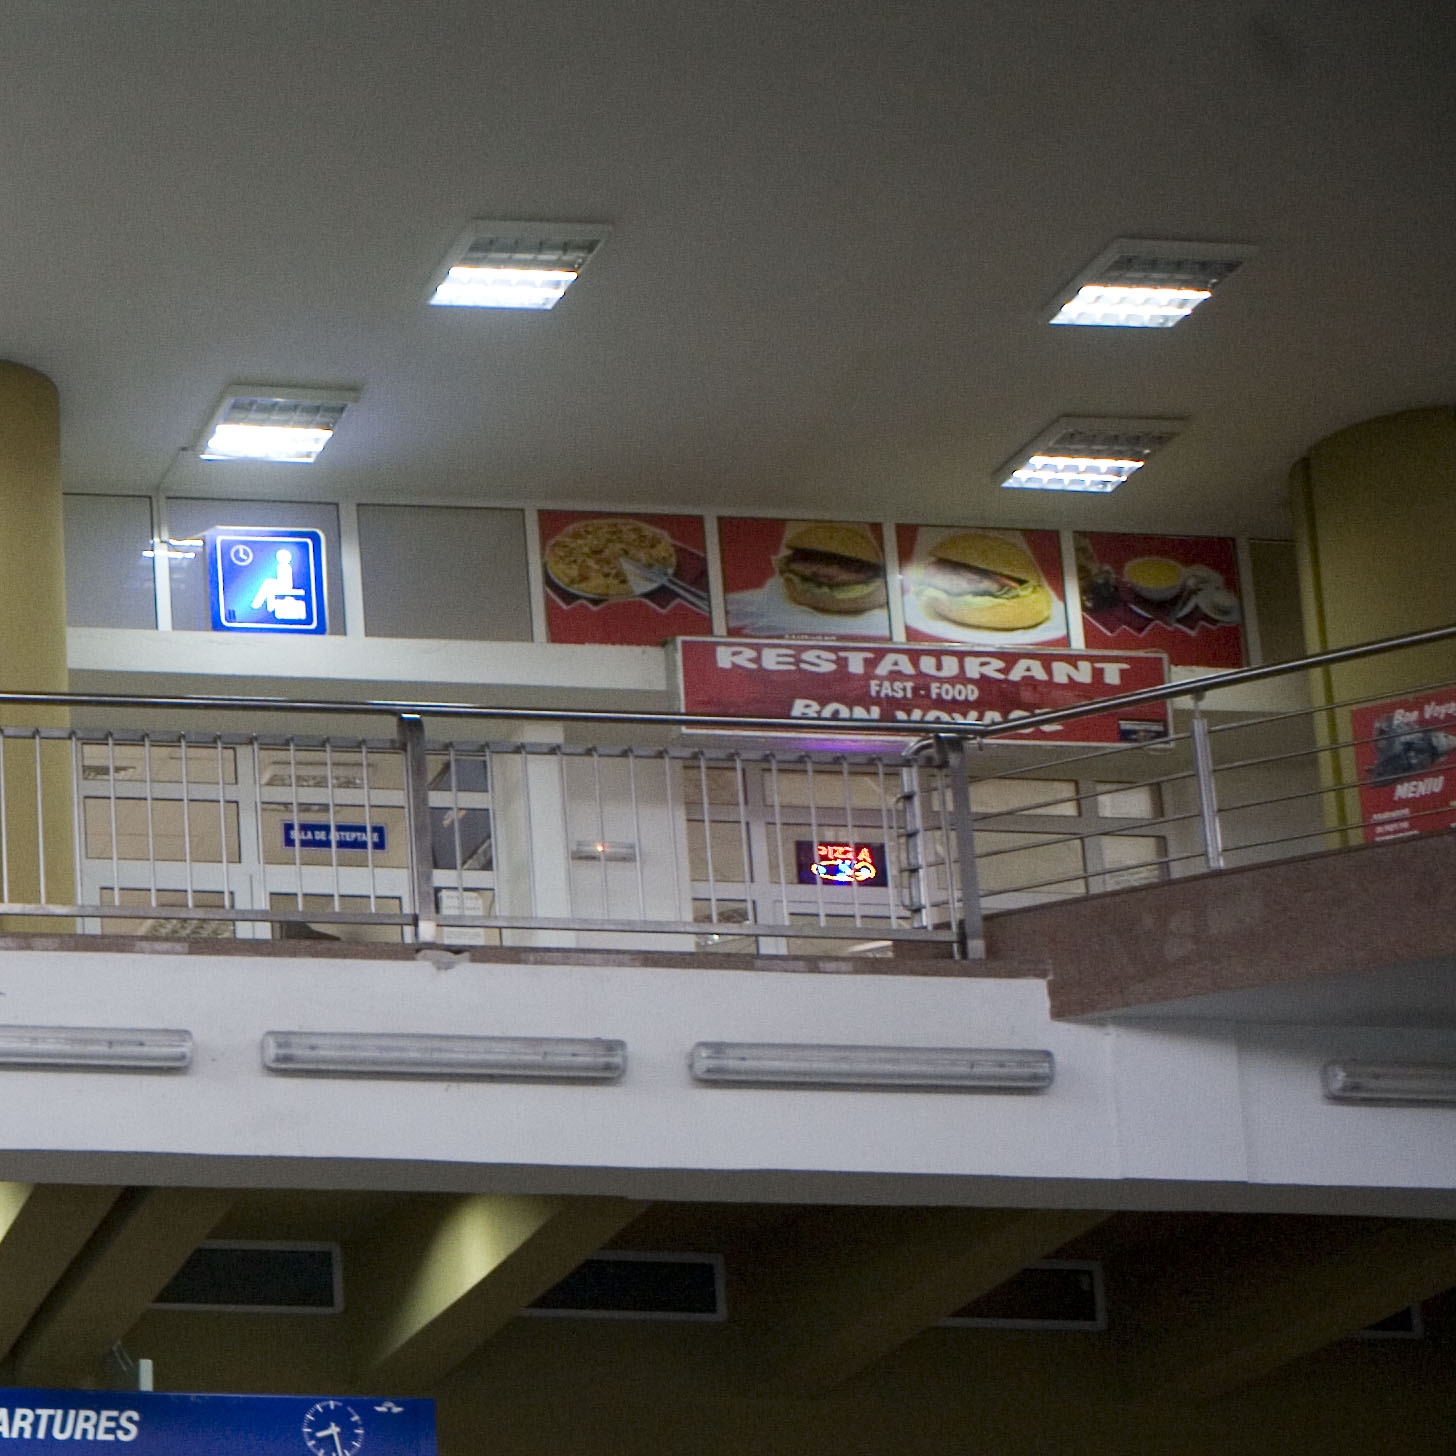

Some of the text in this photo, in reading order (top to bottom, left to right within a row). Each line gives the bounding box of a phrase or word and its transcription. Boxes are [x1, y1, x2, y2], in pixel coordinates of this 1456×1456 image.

[714, 645, 1131, 687] RESTAURANT
[870, 680, 915, 700] FAST
[930, 682, 980, 701] FOOD
